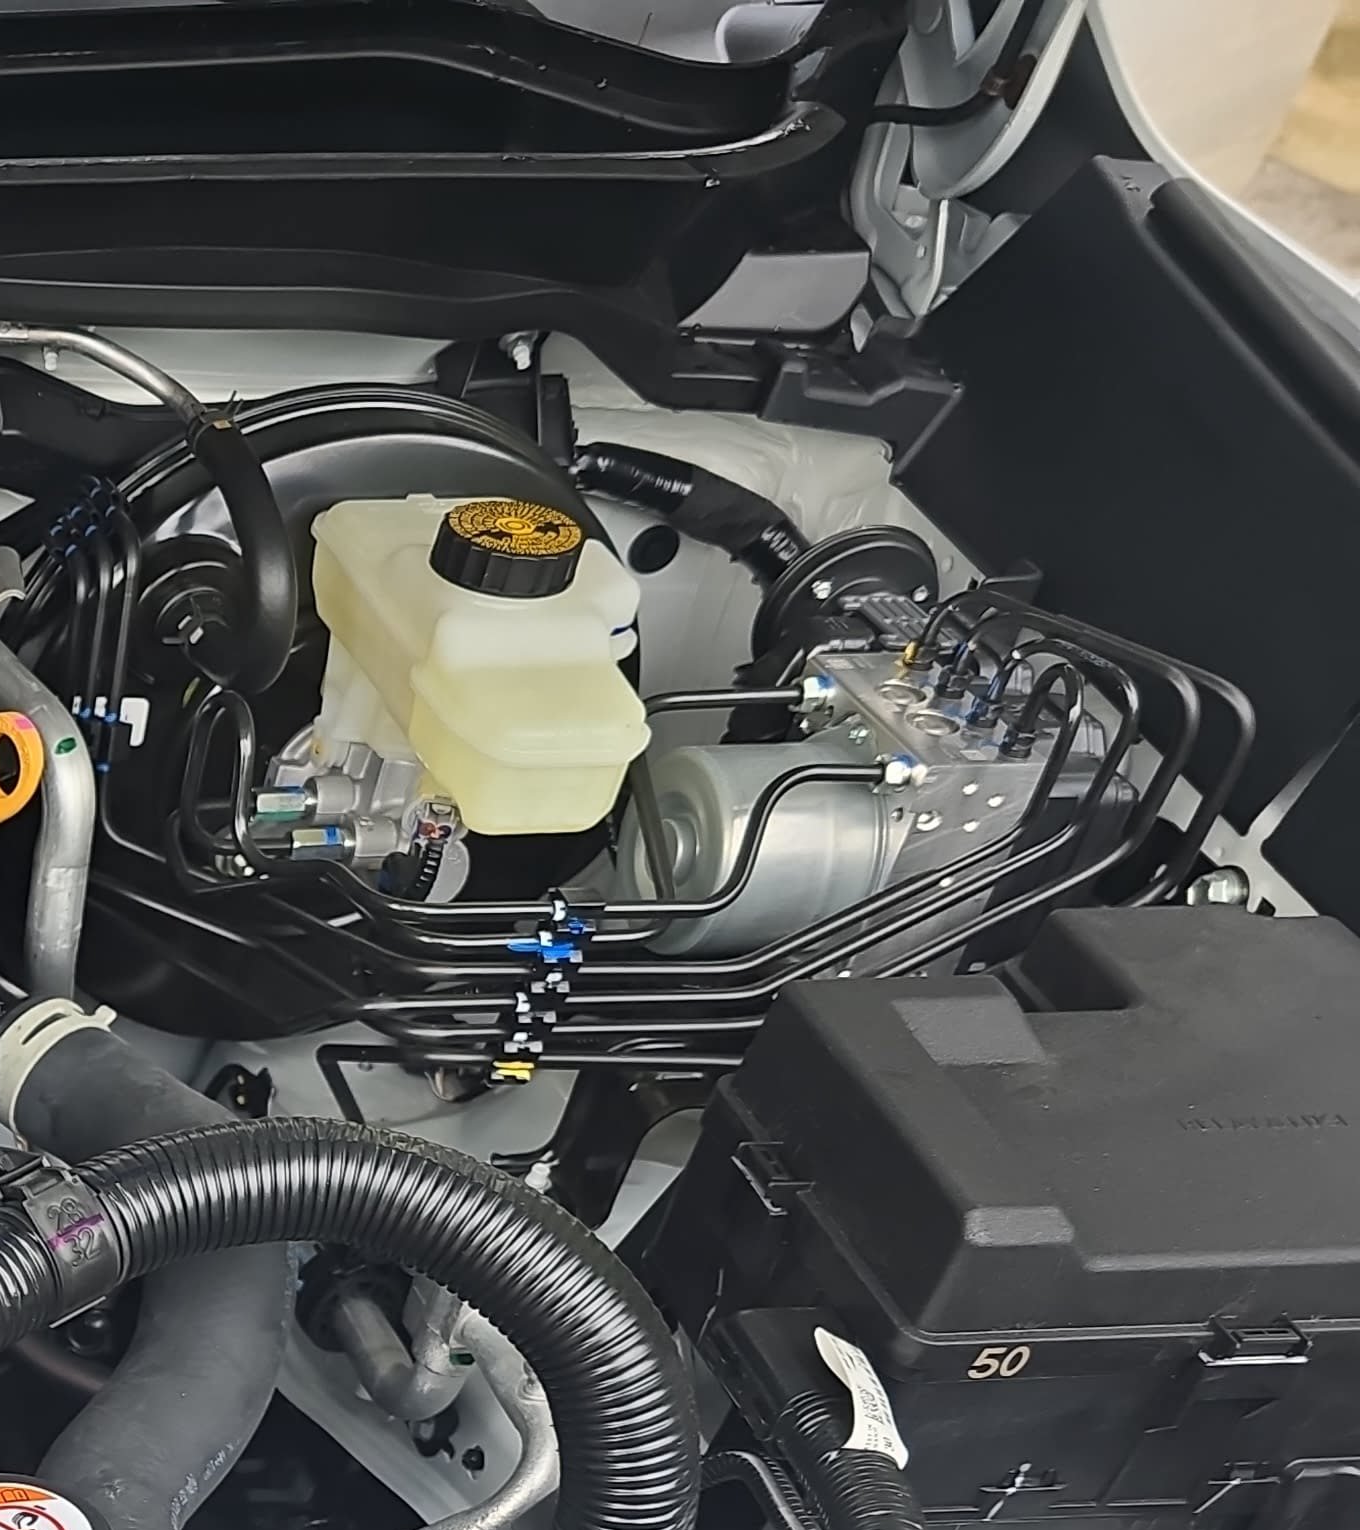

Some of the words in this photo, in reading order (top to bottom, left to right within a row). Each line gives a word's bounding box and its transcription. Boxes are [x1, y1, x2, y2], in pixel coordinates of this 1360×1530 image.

[47, 1197, 84, 1237] 28
[61, 1227, 100, 1267] 32
[968, 1346, 1031, 1379] 50
